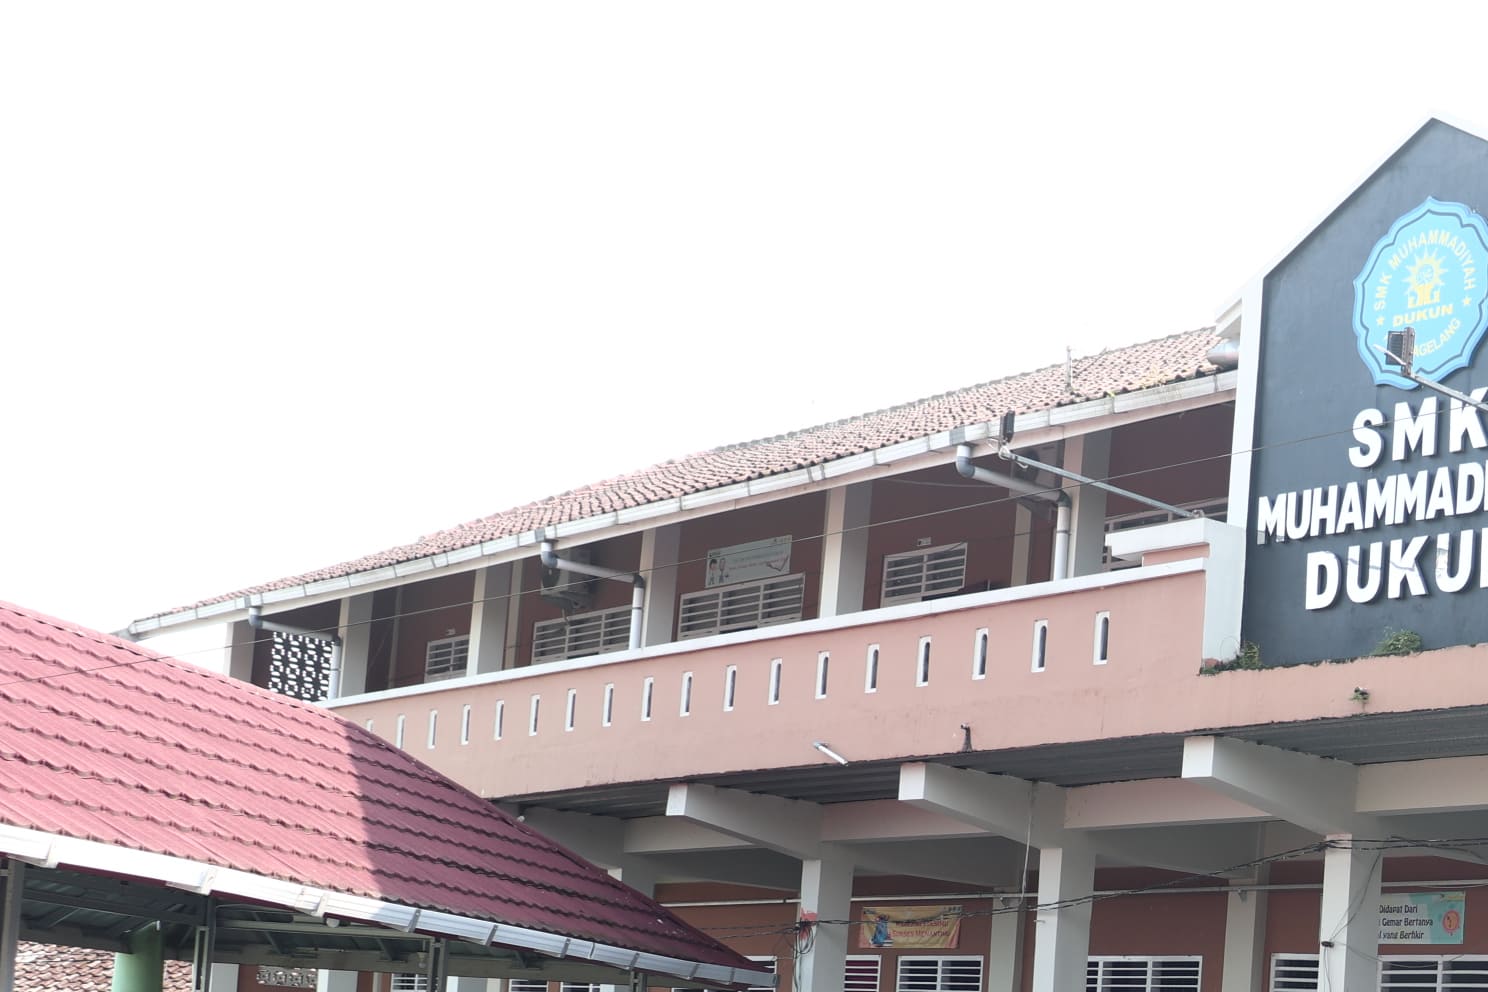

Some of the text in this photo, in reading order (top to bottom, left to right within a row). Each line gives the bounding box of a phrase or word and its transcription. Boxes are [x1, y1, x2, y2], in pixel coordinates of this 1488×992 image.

[1374, 229, 1476, 311] SMK MUHAMMADIYAH
[1393, 304, 1453, 327] DUKUN
[1404, 904, 1418, 913] Dari
[1382, 917, 1433, 928] Gemar Bertanya
